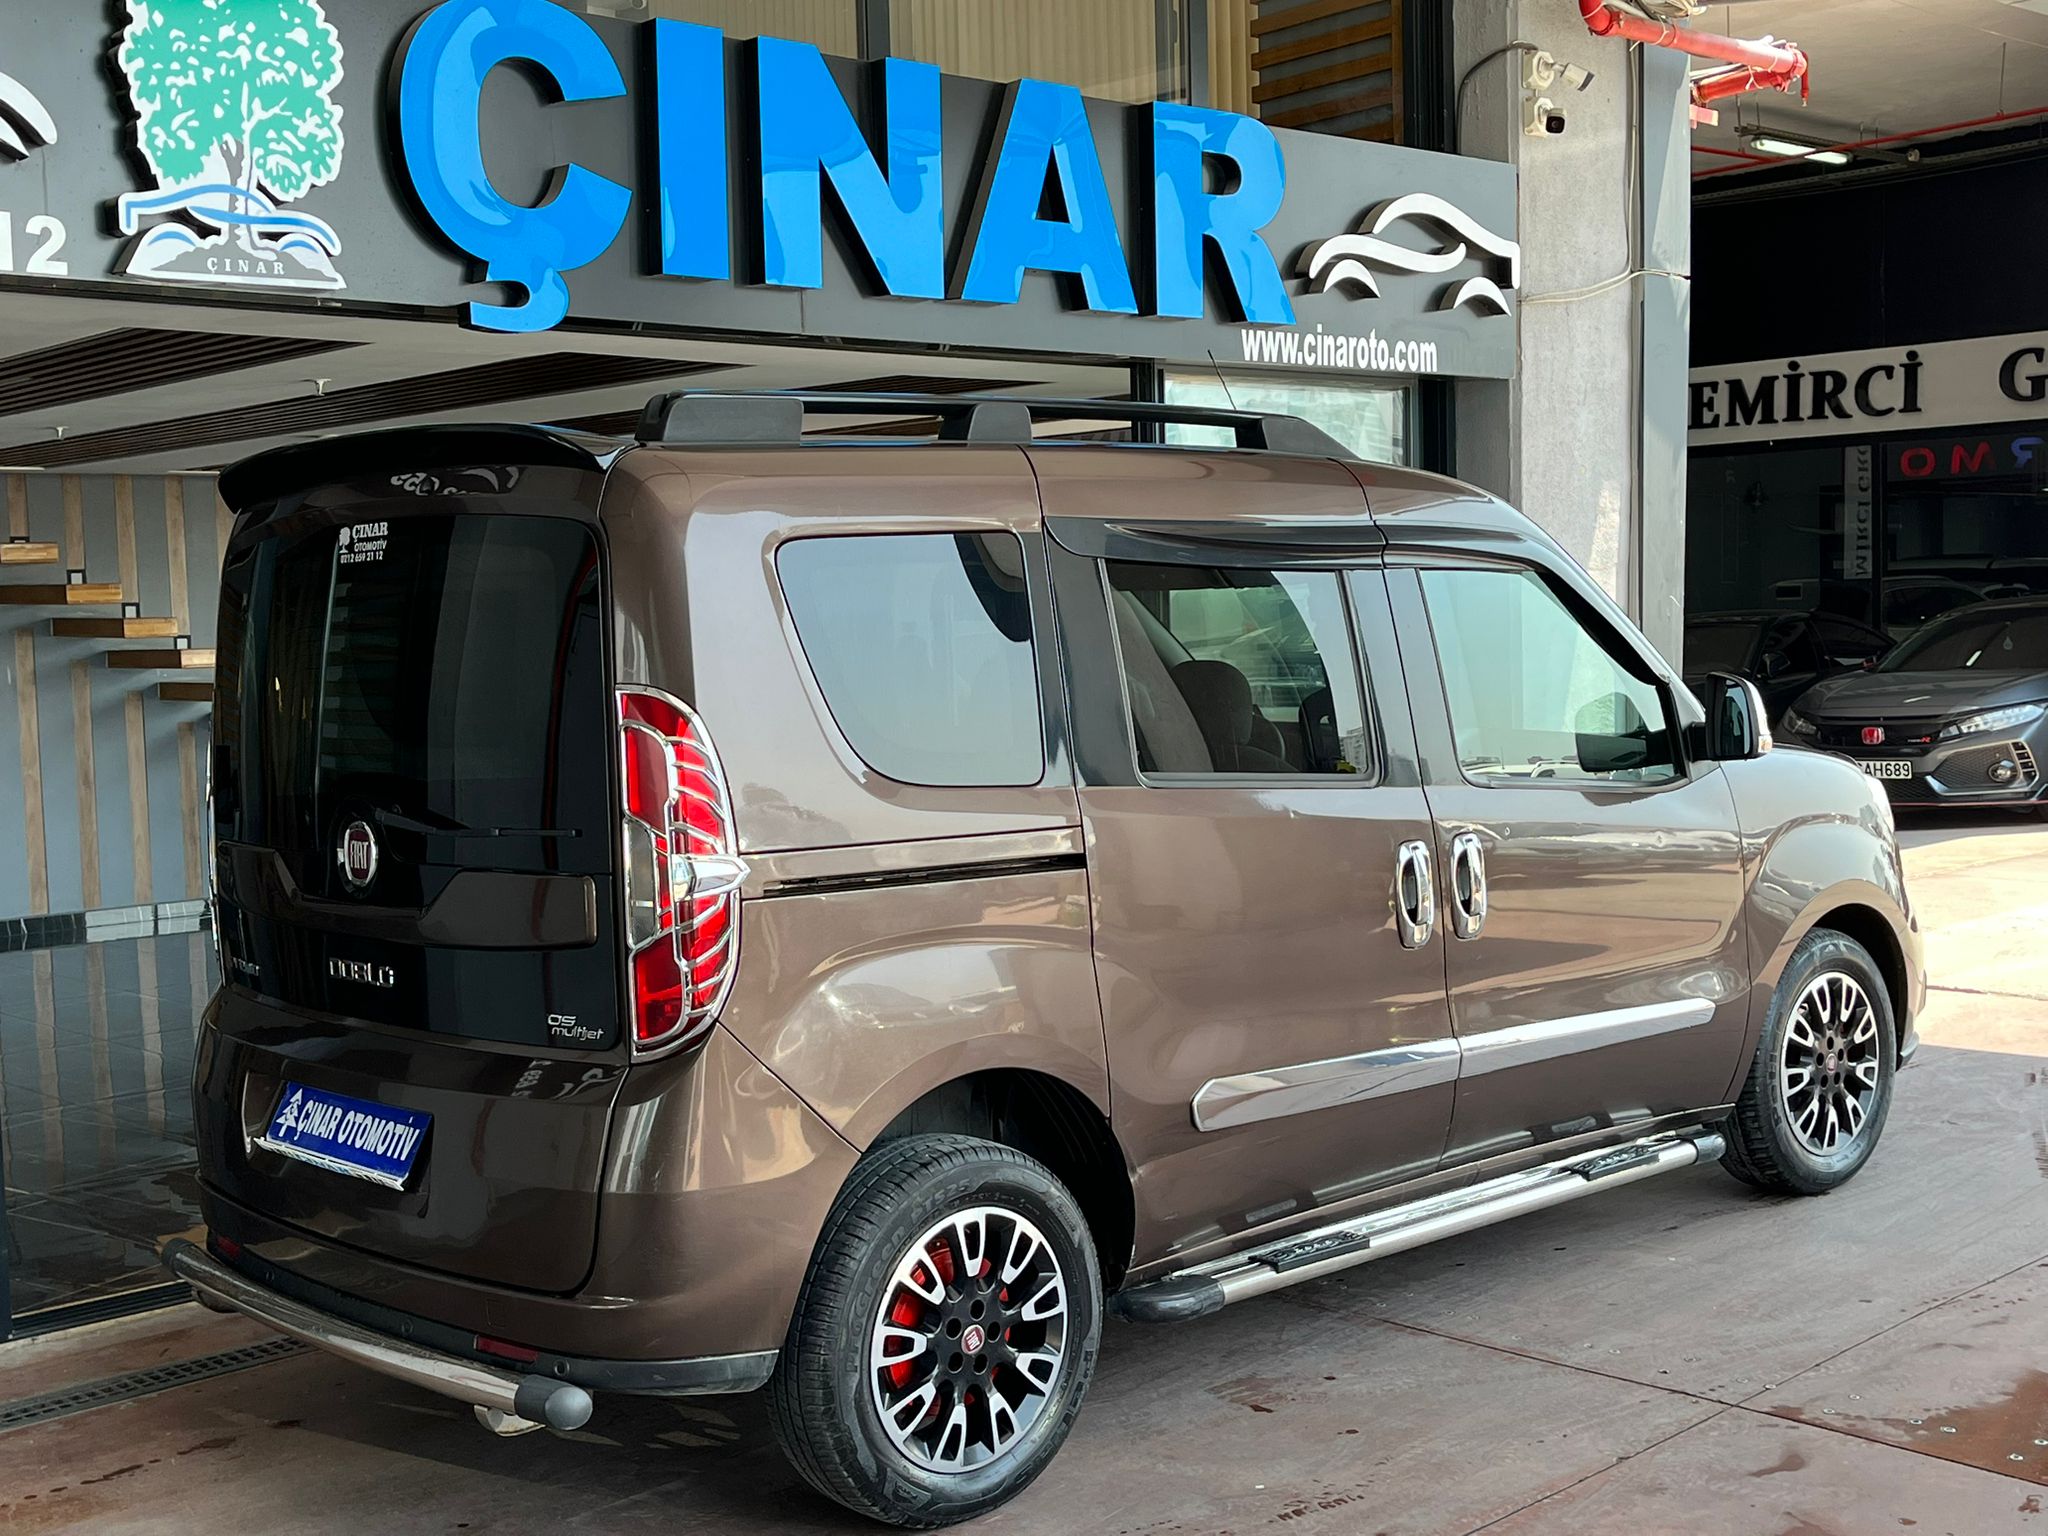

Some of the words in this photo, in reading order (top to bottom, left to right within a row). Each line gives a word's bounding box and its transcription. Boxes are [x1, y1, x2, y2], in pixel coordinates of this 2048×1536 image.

[399, 0, 1296, 333] ÇINAR
[206, 257, 285, 275] ÇINAR
[1241, 323, 1438, 373] www.cinaroto.com
[352, 522, 389, 543] ÇINAR
[376, 550, 384, 560] 12
[1858, 762, 1910, 777] AH689
[350, 840, 369, 870] FIAT
[551, 1025, 605, 1042] multijet
[293, 1099, 344, 1141] ÇINAR
[337, 1110, 421, 1161] OTOMOTİV
